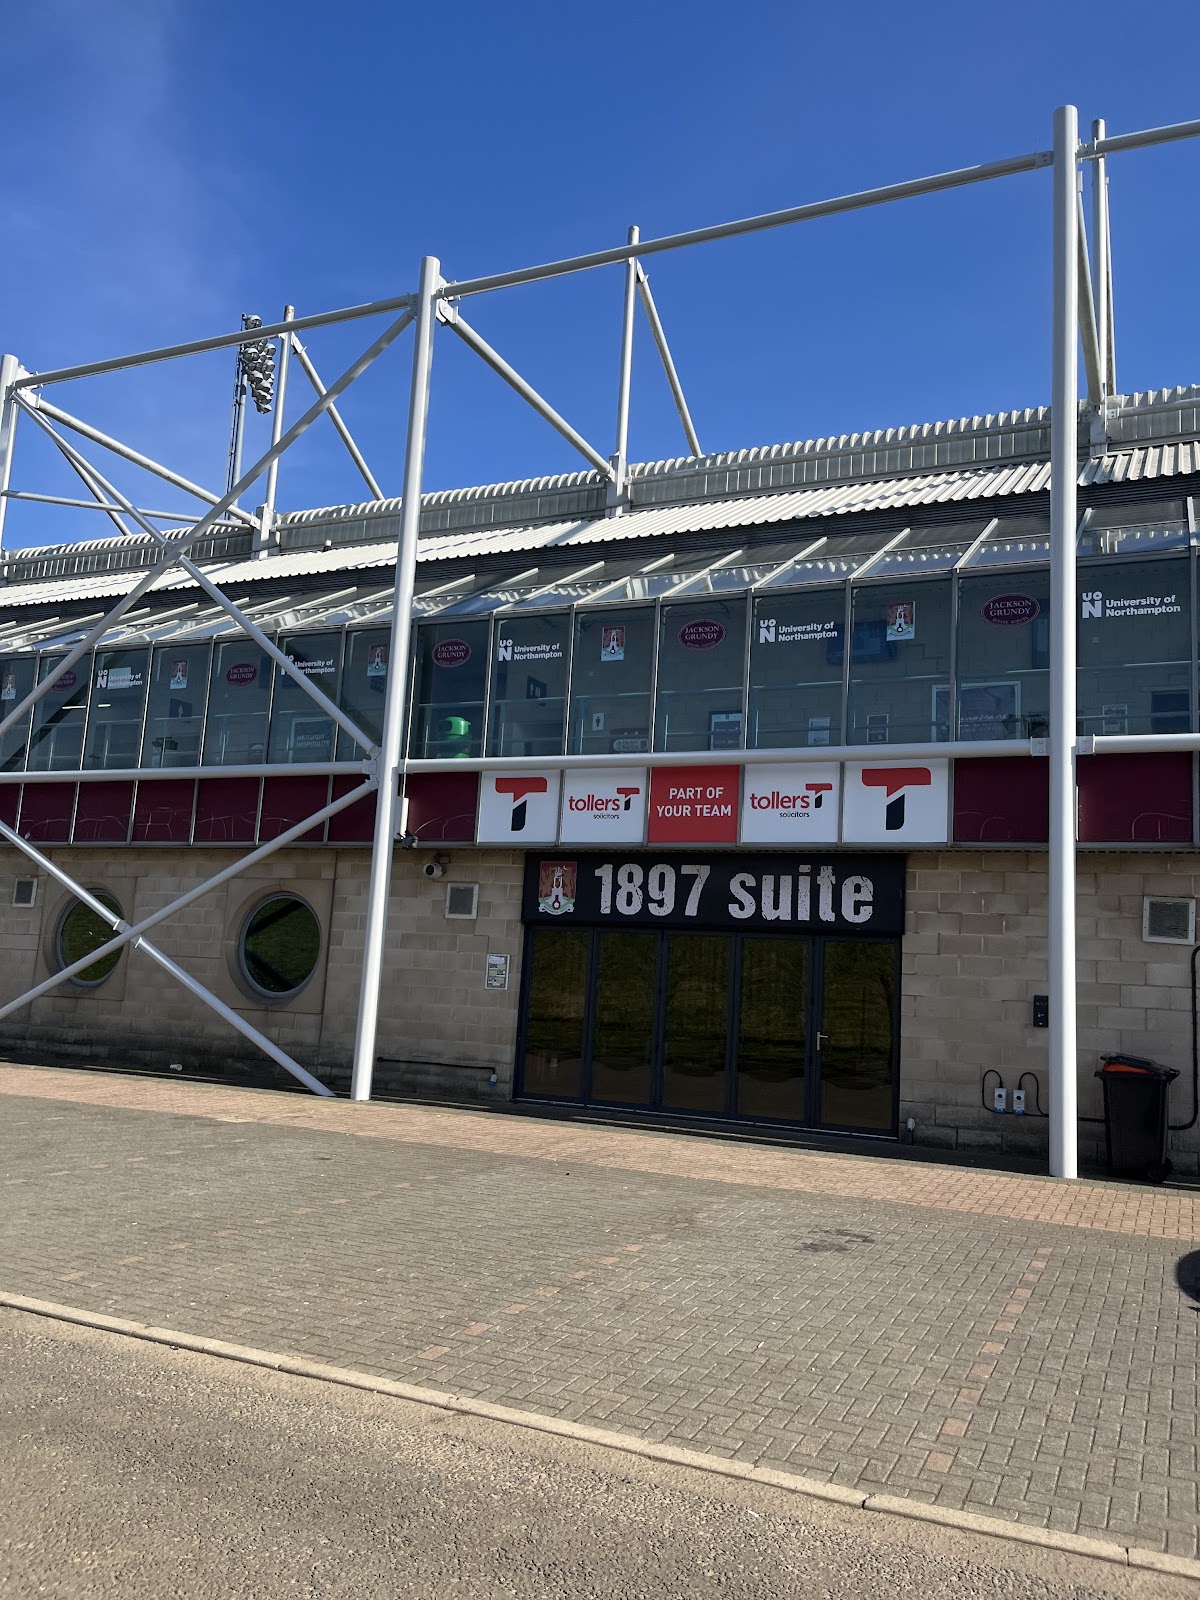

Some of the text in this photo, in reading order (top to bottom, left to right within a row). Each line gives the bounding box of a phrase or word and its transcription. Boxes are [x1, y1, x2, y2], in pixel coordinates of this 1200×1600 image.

[989, 600, 1032, 609] JACKSON
[1105, 594, 1176, 608] University of
[989, 607, 1031, 616] GRUNDY
[1105, 605, 1181, 617] Northampton
[684, 625, 720, 634] JACKSON
[778, 621, 835, 634] University of
[684, 632, 719, 641] GRUNDY
[778, 630, 838, 642] Northampton
[514, 644, 551, 653] University
[437, 650, 466, 658] GRUNDY
[513, 651, 563, 660] Northampton
[294, 660, 325, 668] University
[230, 667, 255, 675] JACKSON
[299, 667, 335, 675] rthampton
[109, 673, 134, 681] University
[108, 680, 143, 688] Northampton
[669, 786, 724, 800] PART OF
[568, 794, 620, 812] tollers
[750, 791, 810, 811] tollers
[656, 804, 732, 817] YOUR TEAM
[595, 863, 874, 924] 1897 suite
